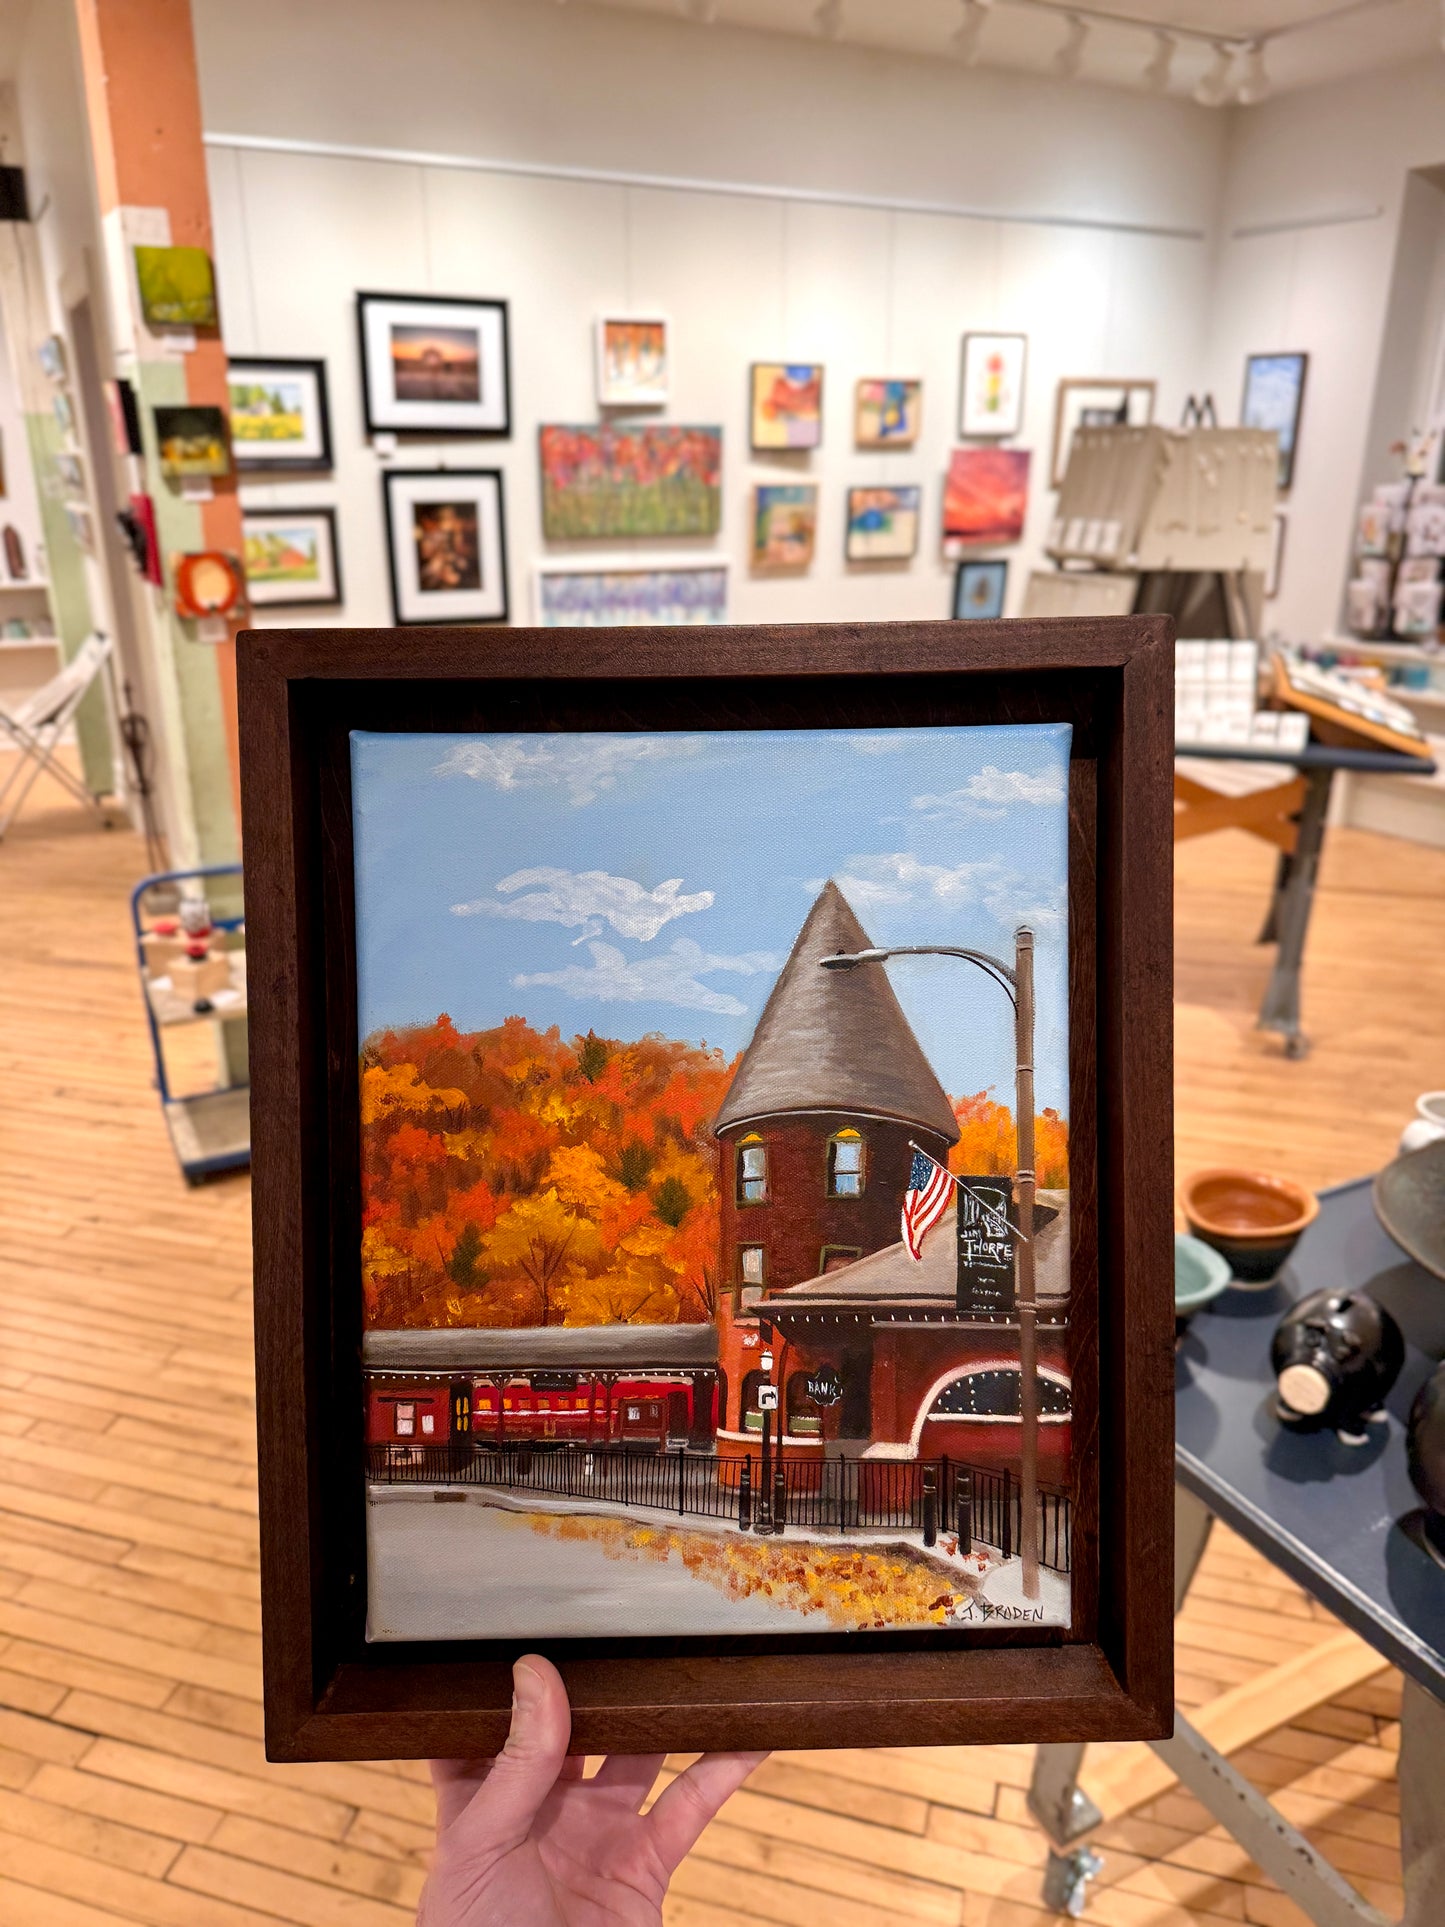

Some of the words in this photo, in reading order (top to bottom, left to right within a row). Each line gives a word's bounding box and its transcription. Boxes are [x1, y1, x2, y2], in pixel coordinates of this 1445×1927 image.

[963, 1238, 1013, 1263] THORPE
[807, 1380, 836, 1397] BANK
[961, 1600, 978, 1621] J.
